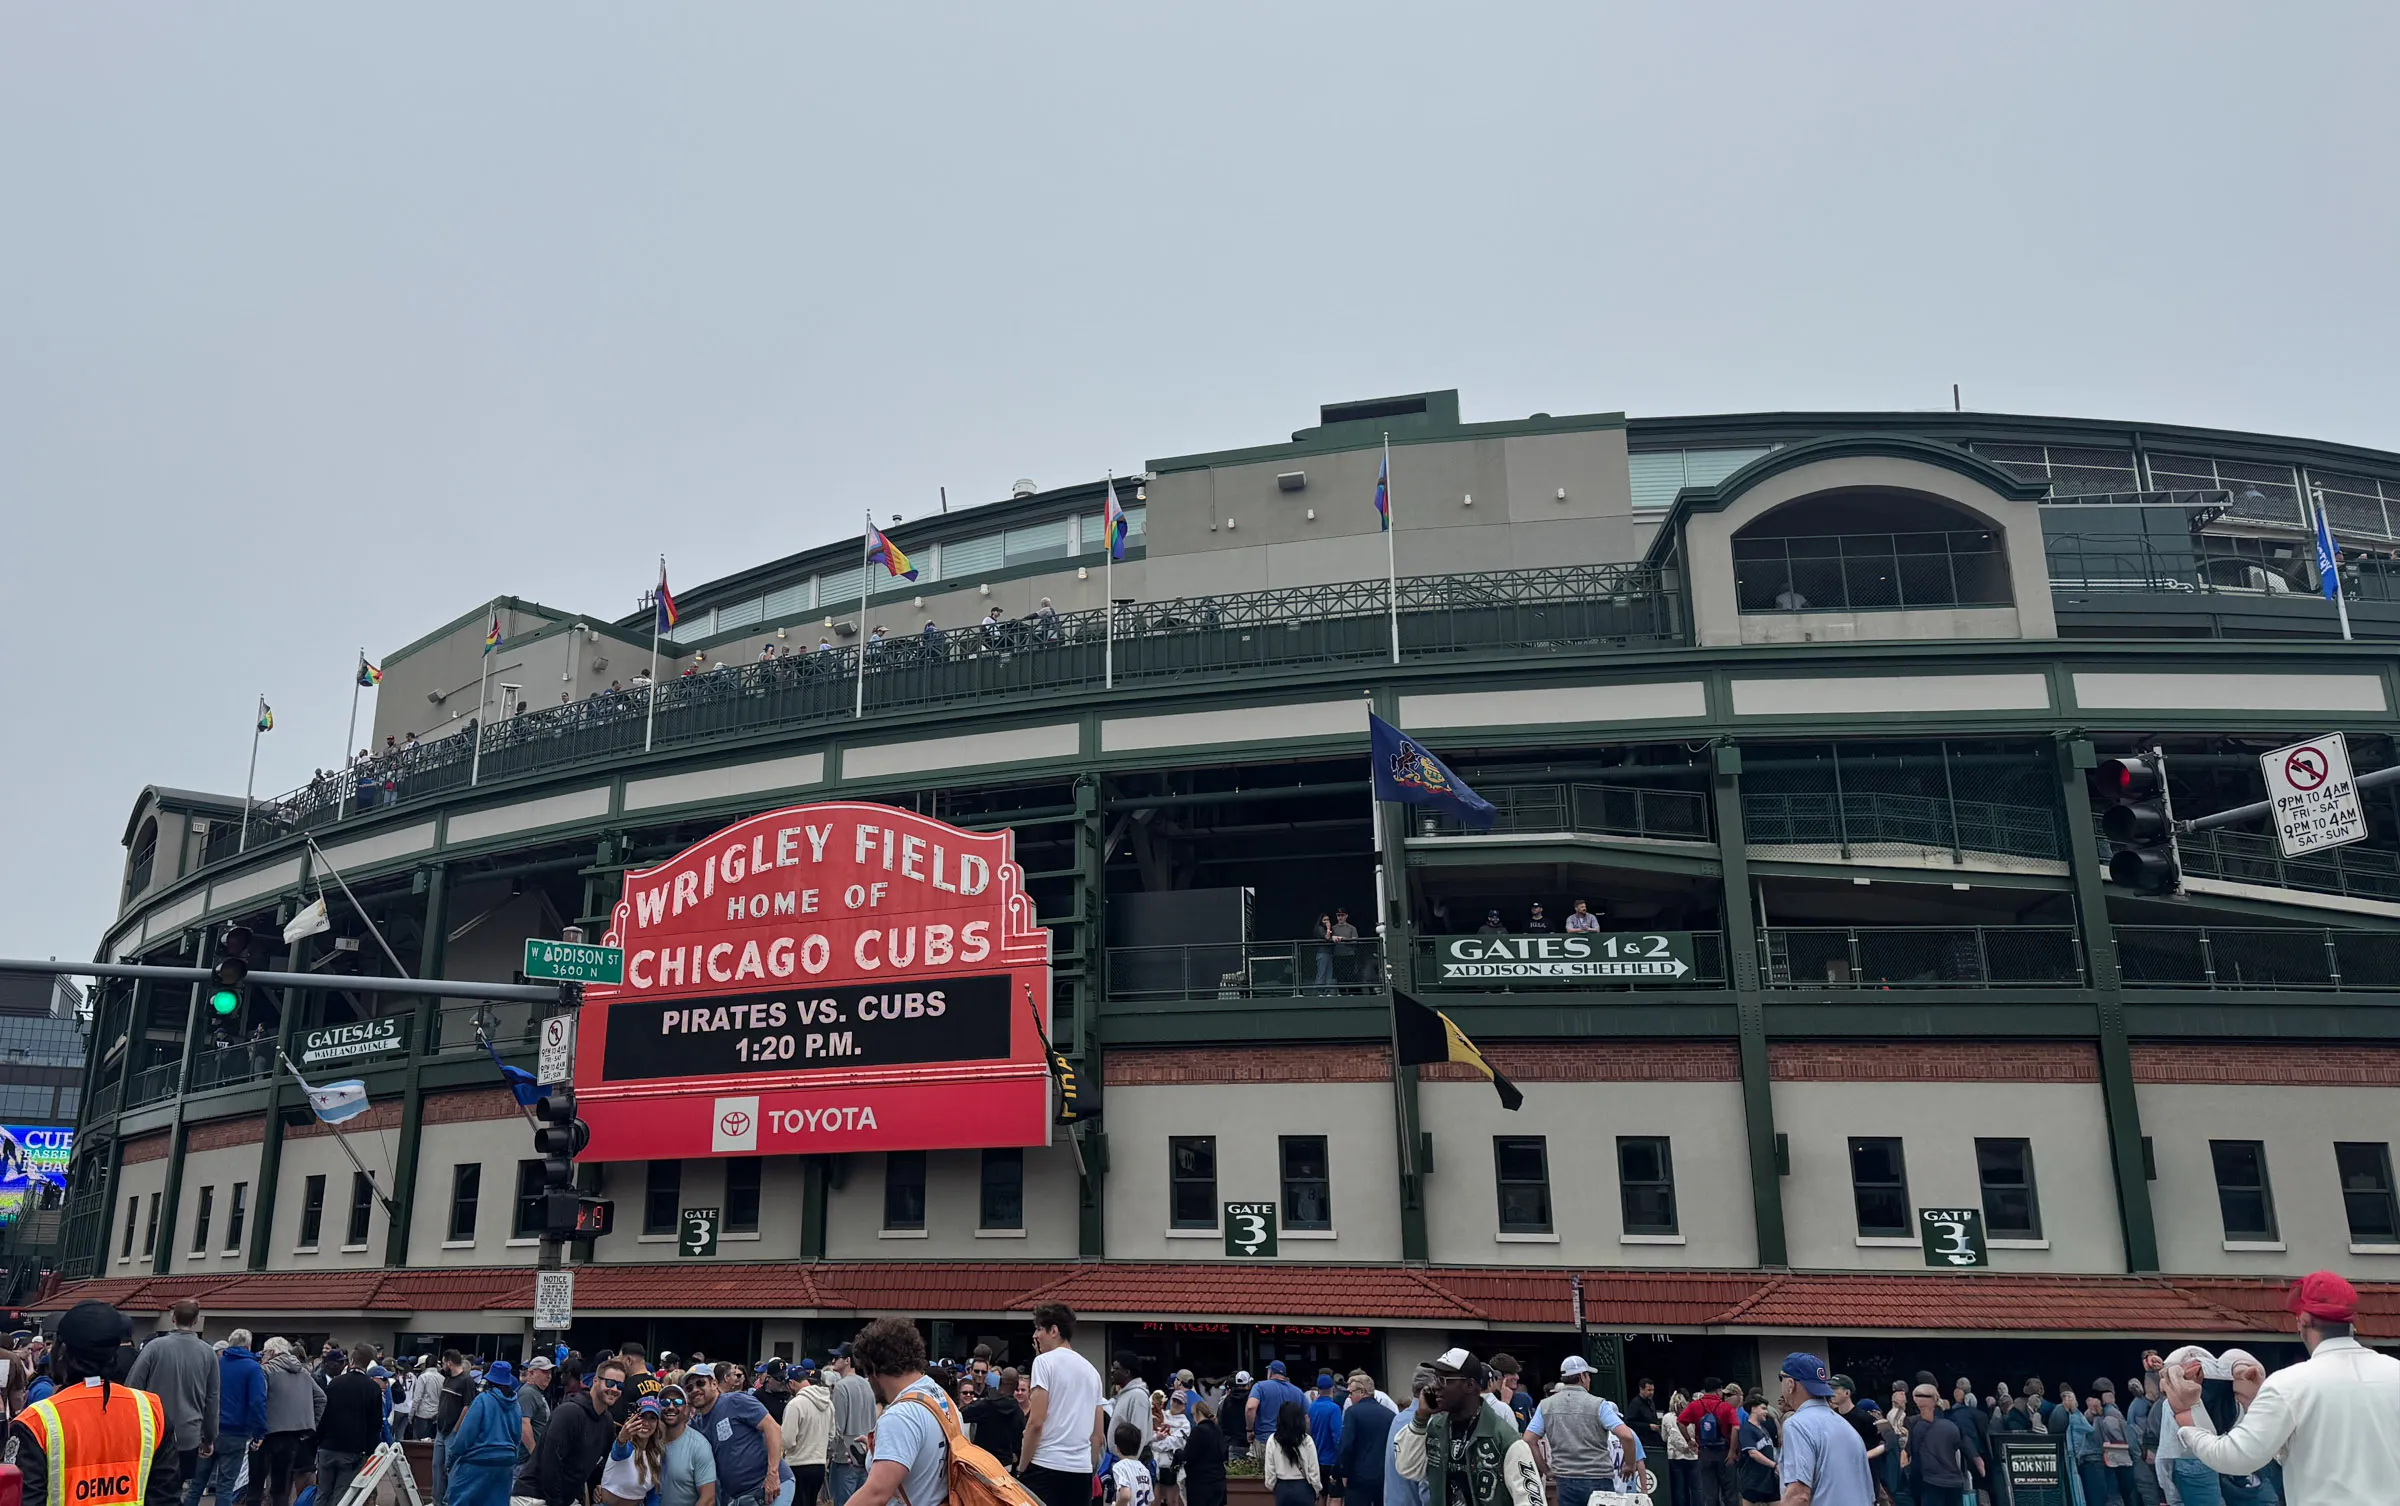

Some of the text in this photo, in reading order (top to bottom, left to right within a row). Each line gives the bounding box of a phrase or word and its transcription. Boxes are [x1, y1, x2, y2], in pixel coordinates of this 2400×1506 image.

[2278, 781, 2350, 812] 9PM TO 4AM
[2292, 808, 2311, 820] FRI
[2320, 800, 2340, 813] SAT
[2284, 808, 2357, 838] 9PM TO 4AM
[635, 823, 990, 929] WRIGLEY FIELD
[727, 881, 889, 921] HOME OF
[531, 946, 619, 965] W ADDISON ST
[628, 920, 991, 989] CHICAGO CUBS
[1450, 936, 1591, 961] GATES
[552, 964, 598, 977] 3600 N
[1452, 962, 1676, 976] ADDISON & SHEFFIELD
[661, 990, 946, 1035] PIRATES VS. CUBS
[307, 1025, 363, 1048] GATES
[735, 1031, 862, 1062] 1:20 P.M.
[315, 1041, 388, 1059] WAVELAND AVENUE
[768, 1106, 878, 1134] TOYOTA
[684, 1209, 718, 1219] GATE
[1227, 1204, 1273, 1214] GATE
[686, 1219, 710, 1246] 3
[1234, 1214, 1267, 1245] 3
[543, 1275, 567, 1283] NOTICE
[76, 1475, 130, 1500] OEMC
